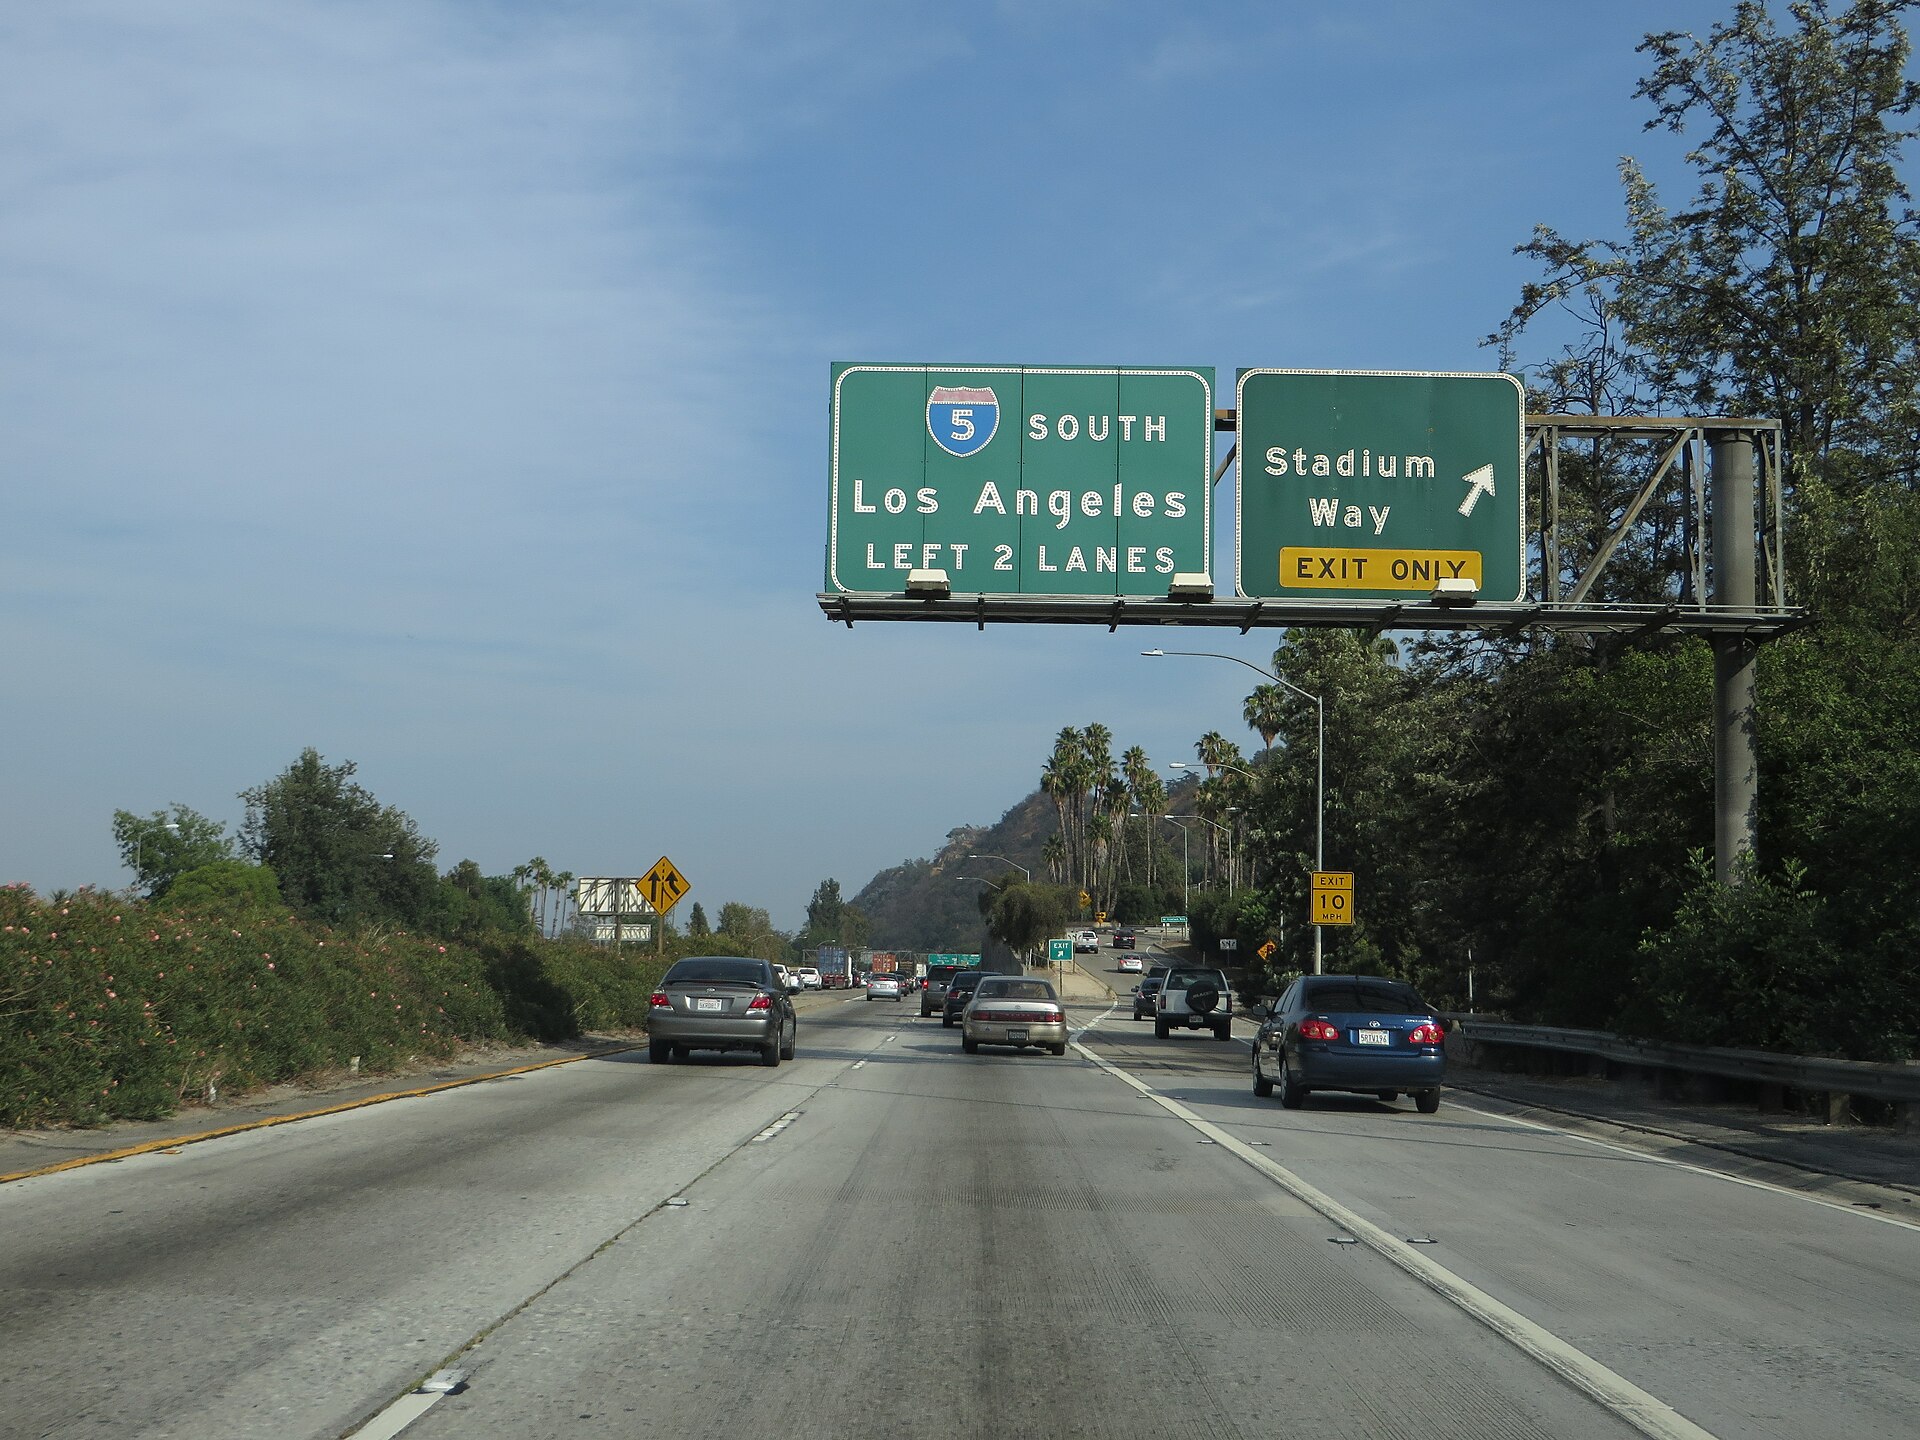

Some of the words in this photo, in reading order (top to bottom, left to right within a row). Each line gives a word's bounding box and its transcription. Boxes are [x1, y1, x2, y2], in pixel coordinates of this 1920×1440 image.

[950, 409, 975, 441] 5
[1028, 414, 1167, 443] SOUTH
[1264, 446, 1436, 479] Stadium
[854, 480, 939, 514] Los
[973, 481, 1187, 530] Angeles
[1308, 498, 1391, 535] Way
[866, 543, 969, 570] LEFT
[993, 544, 1014, 571] 2
[1038, 545, 1176, 574] LANES
[1297, 557, 1368, 580] EXIT
[1391, 559, 1467, 581] ONLY
[1320, 877, 1345, 886] EXIT
[1320, 894, 1345, 910] 10
